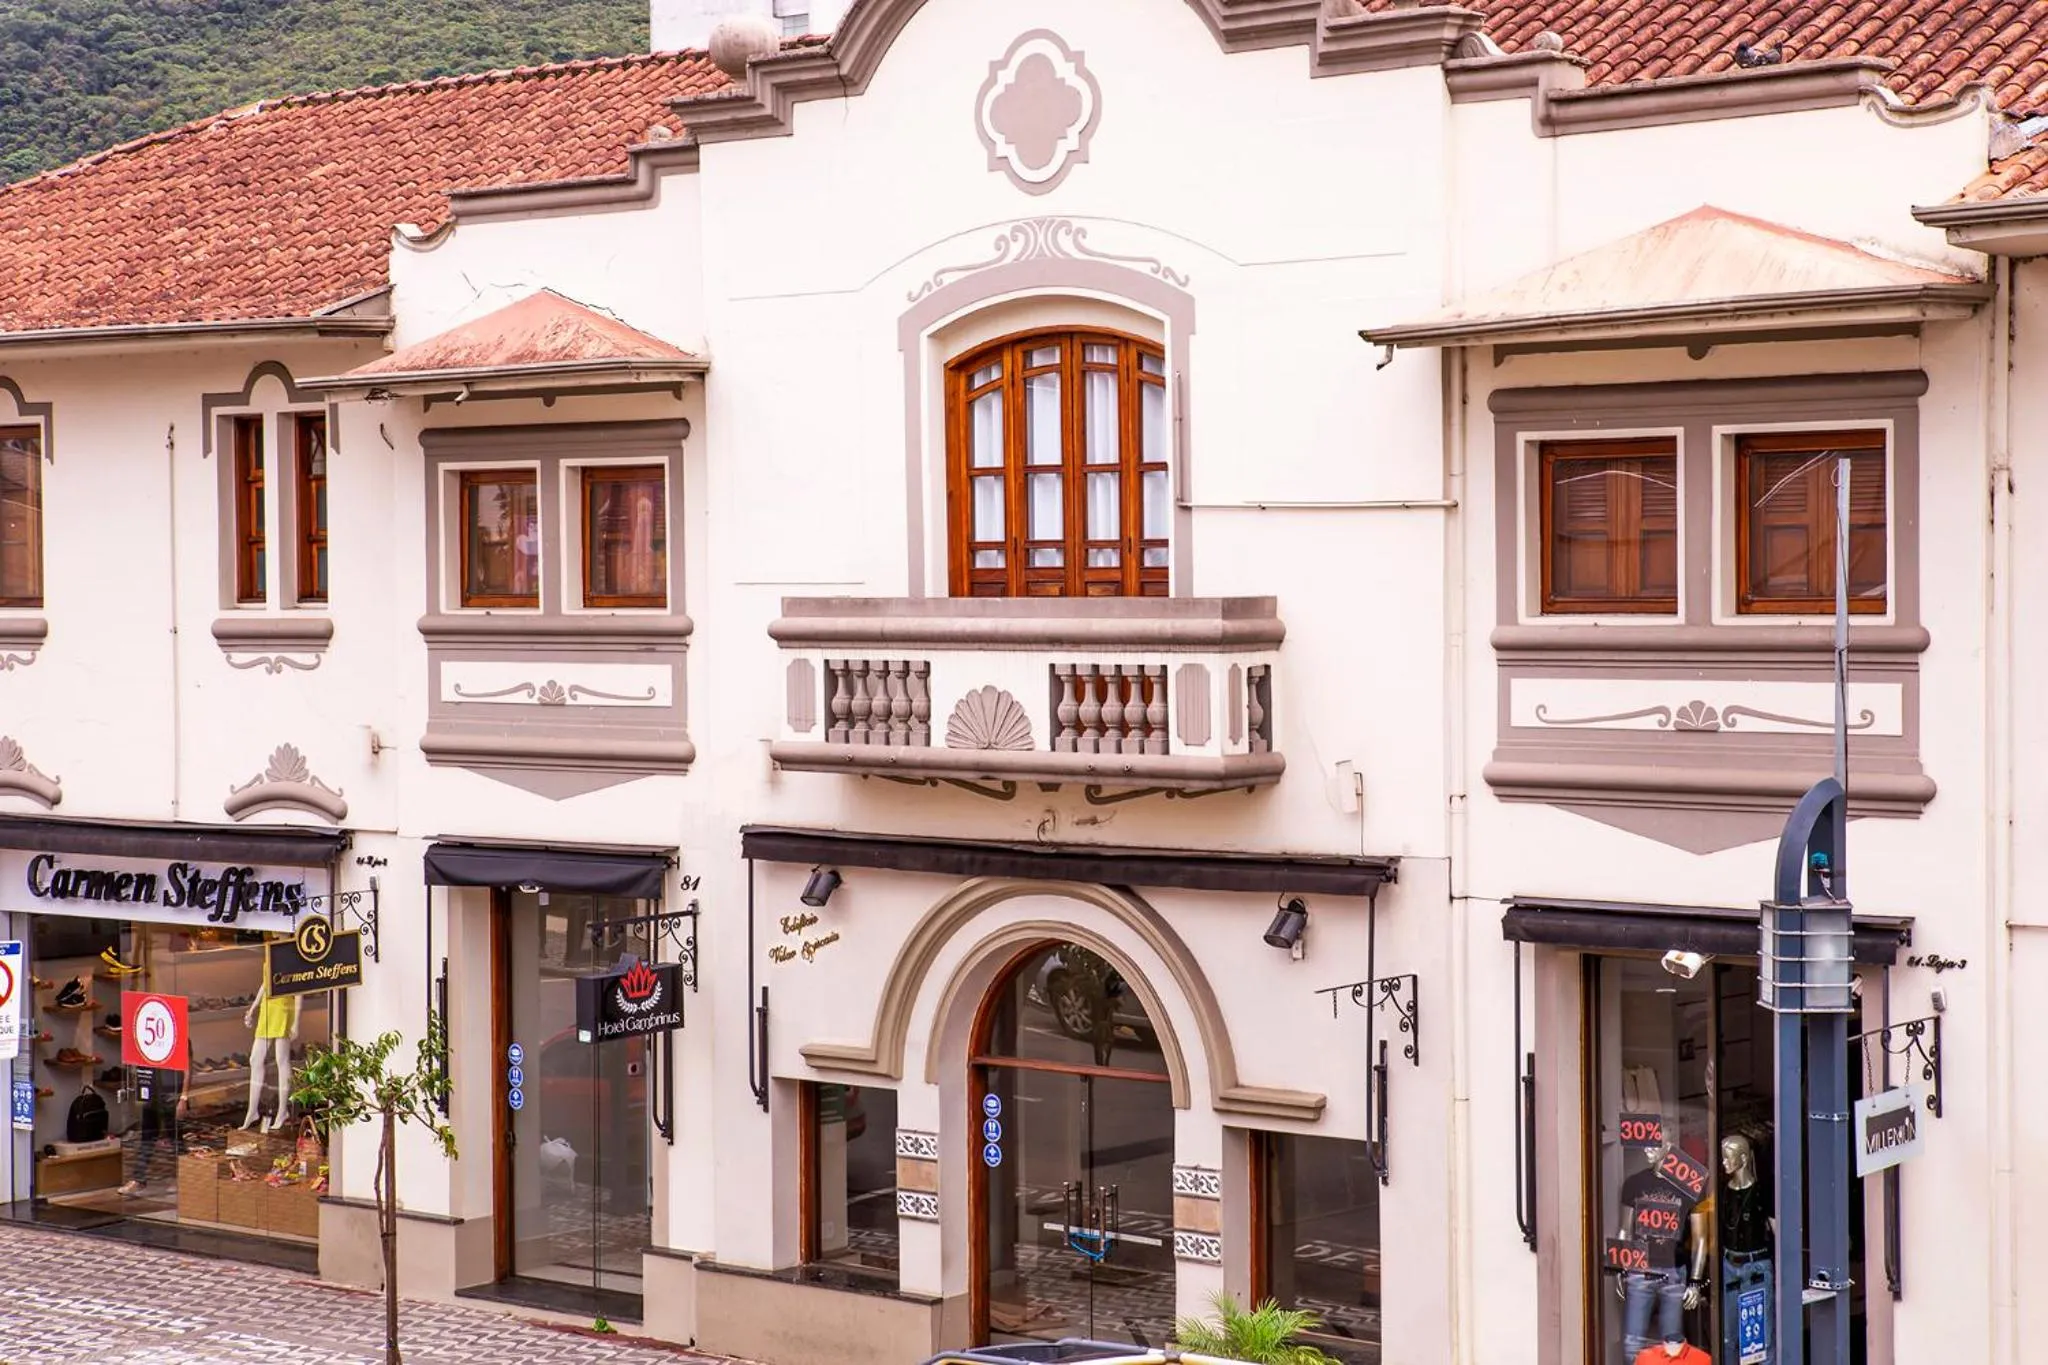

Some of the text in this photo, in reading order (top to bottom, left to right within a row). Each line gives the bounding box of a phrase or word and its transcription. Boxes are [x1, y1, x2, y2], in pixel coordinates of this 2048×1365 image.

[27, 854, 307, 923] Carmen Steffens
[681, 875, 701, 891] 81
[273, 963, 358, 985] Carmen Steffens
[144, 1017, 165, 1046] 50
[598, 1011, 681, 1036] Hotel Gambrinus
[1620, 1121, 1662, 1141] 30%
[1663, 1153, 1705, 1193] 20%
[1638, 1209, 1678, 1231] 40%
[1608, 1247, 1648, 1269] 10%
